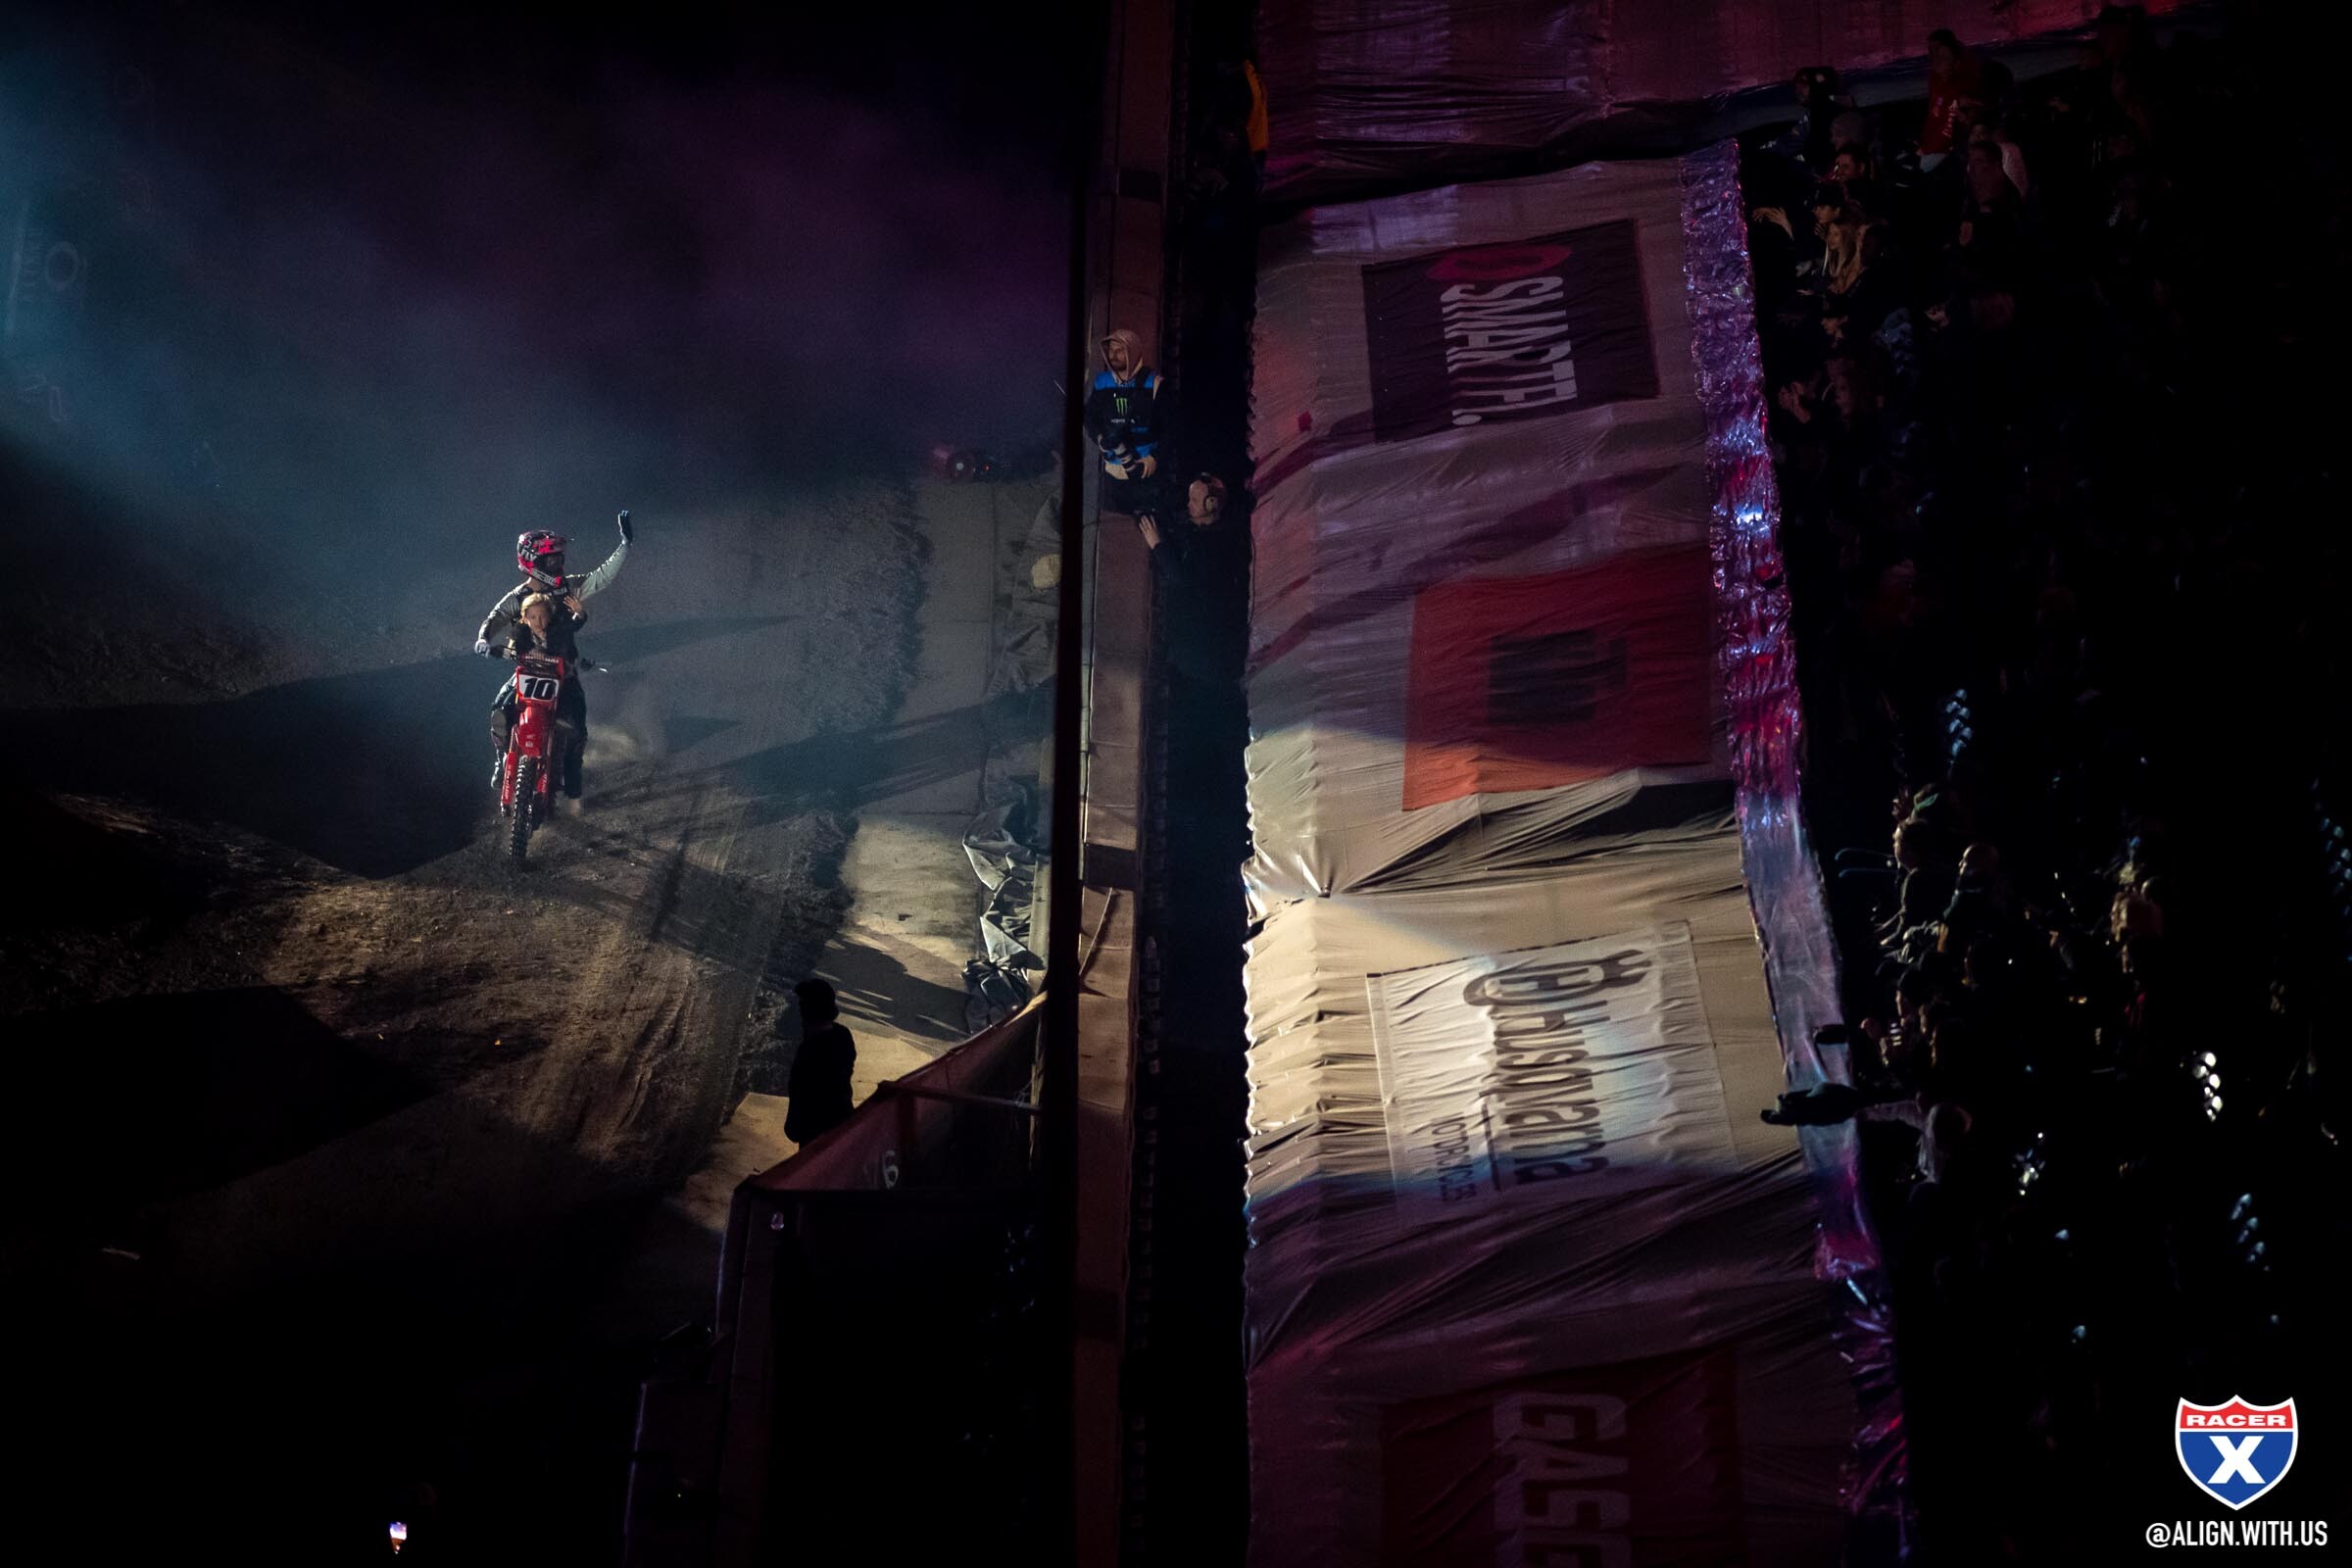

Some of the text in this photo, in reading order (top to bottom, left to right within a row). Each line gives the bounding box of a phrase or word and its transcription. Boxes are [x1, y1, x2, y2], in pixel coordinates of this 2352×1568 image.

[520, 549, 538, 563] FLY
[523, 677, 557, 701] 10
[1479, 1000, 1610, 1185] Husqvarna
